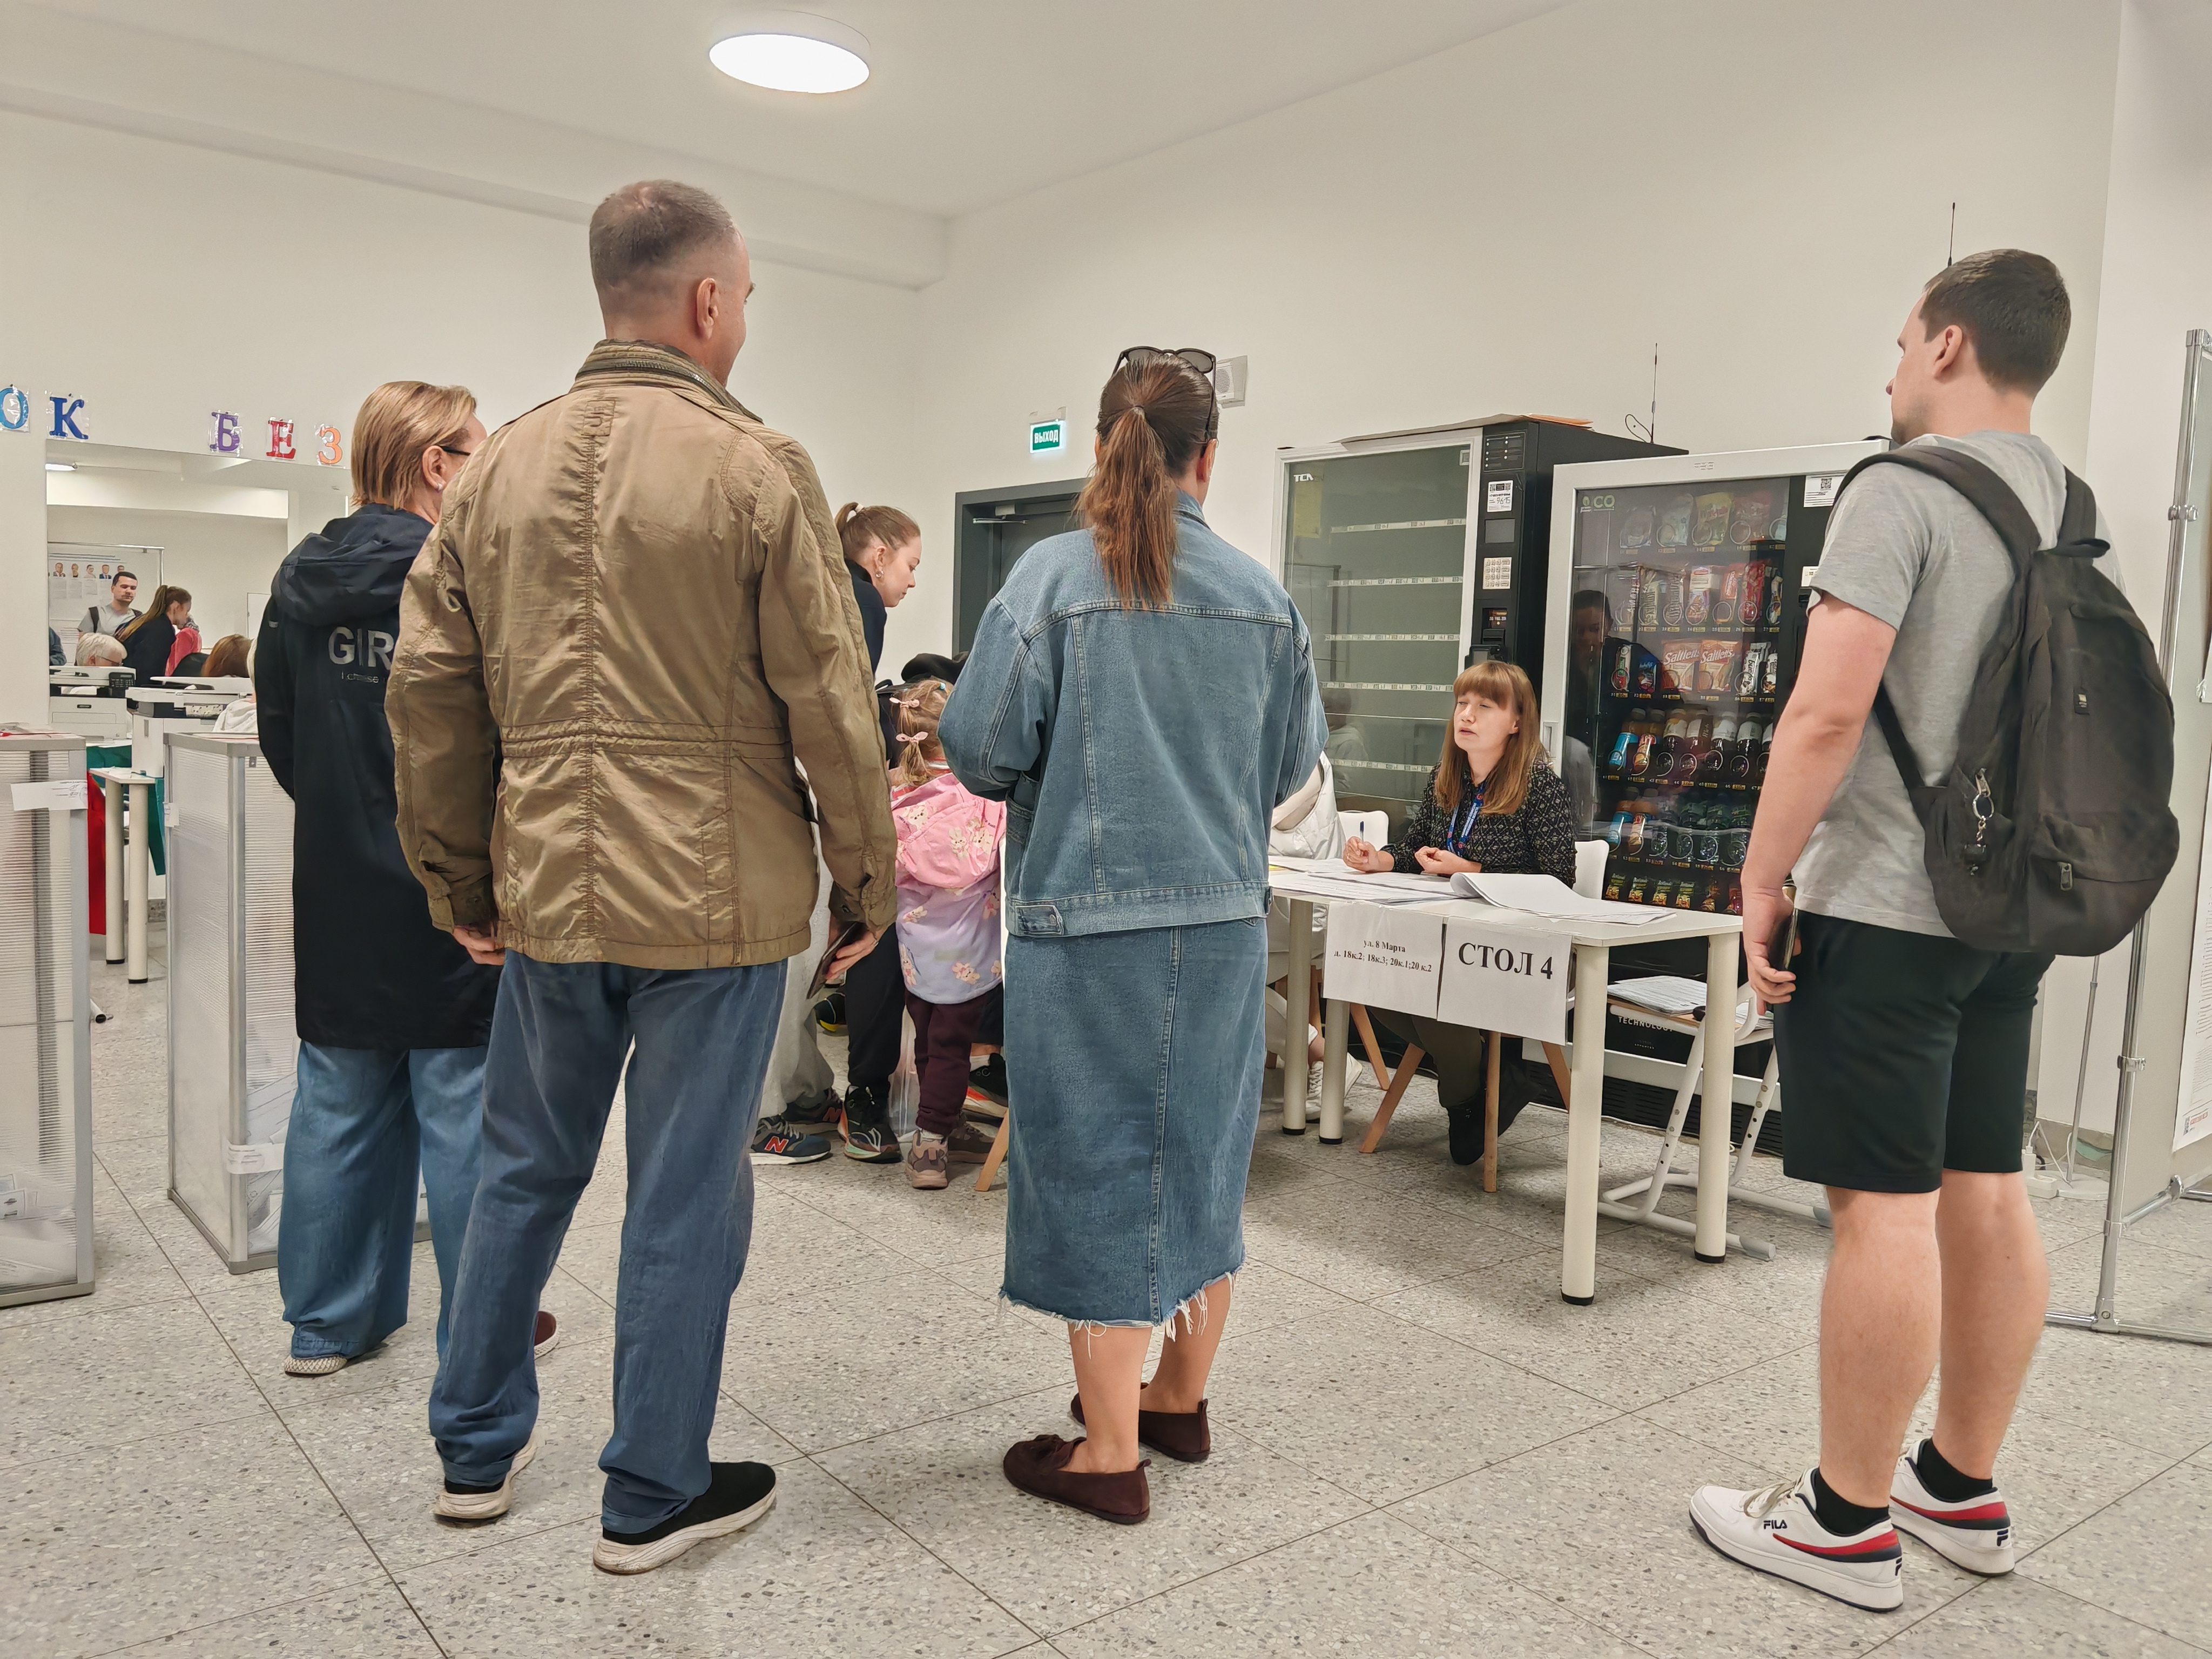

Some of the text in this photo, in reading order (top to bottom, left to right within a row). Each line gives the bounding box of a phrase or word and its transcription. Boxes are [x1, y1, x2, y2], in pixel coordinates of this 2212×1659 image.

[1034, 429, 1058, 443] ВЫХОД
[328, 626, 394, 670] GIR
[1375, 940, 1380, 948] 8
[1381, 941, 1406, 953] Марта
[1459, 942, 1553, 980] СТОЛ 4
[764, 1136, 789, 1153] N
[1763, 1519, 1788, 1529] FILA
